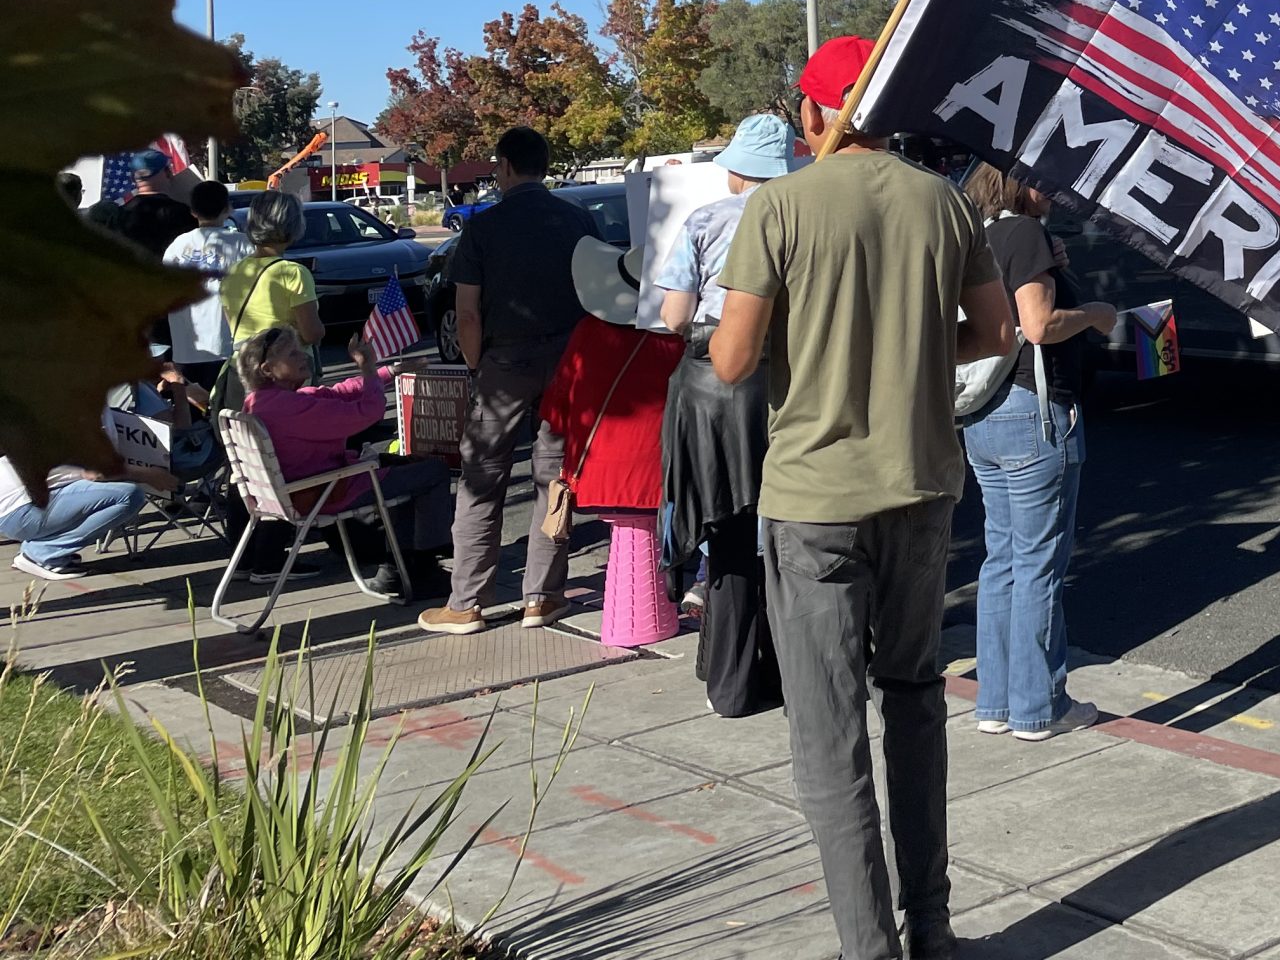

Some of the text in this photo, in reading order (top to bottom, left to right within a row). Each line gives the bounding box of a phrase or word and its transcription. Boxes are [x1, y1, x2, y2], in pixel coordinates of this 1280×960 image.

[402, 378, 464, 398] OUR DEMOCRACY
[414, 399, 457, 417] NEEDS YOUR
[414, 418, 459, 441] COURAGE
